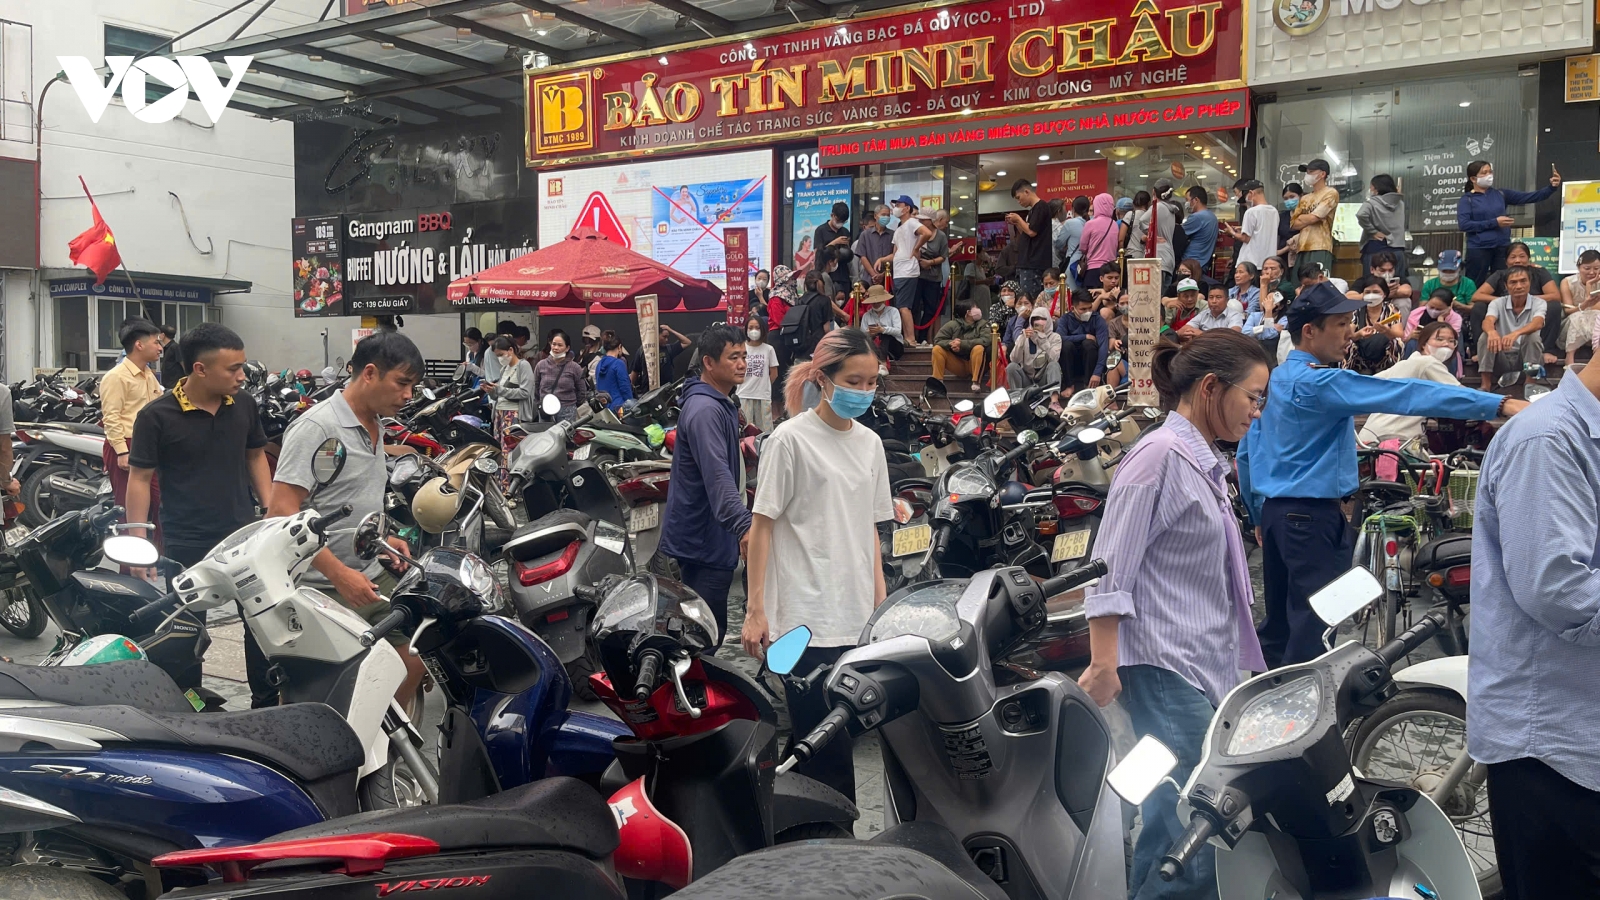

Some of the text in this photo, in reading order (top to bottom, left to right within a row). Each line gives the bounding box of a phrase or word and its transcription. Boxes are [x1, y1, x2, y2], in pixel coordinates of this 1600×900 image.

[720, 44, 759, 65] CÔNG
[763, 43, 781, 59] TY
[783, 38, 822, 56] TNHH
[825, 28, 863, 49] VÀNG
[867, 27, 898, 46] BẠC
[904, 17, 924, 36] ĐÁ
[930, 10, 961, 31] QUÝ
[1008, 0, 1045, 19] LTD)
[603, 0, 1222, 131] BẢO TÍN MINH CHÂU
[620, 64, 1188, 147] KINH DOANH CHẾ TÁC TRANG SỨC VÀNG BẠC ĐÁ QUÝ KIM CƯƠNG MỸ NGHỆ
[820, 98, 1240, 157] TRUNG TÂM MUA BÁN VÀNG MIẾNG ĐƯỢC NHÀ NƯỚC CẤP PHÉP
[544, 132, 584, 144] BTMC 1989
[786, 152, 823, 181] 139
[1423, 164, 1462, 176] Moon
[348, 211, 451, 240] Gangnam BBQ
[347, 257, 372, 281] BUFFET
[374, 240, 434, 286] NƯỚNG
[438, 252, 448, 275] &
[450, 227, 486, 282] LẨU
[63, 283, 87, 292] COMPLEX
[109, 284, 121, 293] CÔNG
[490, 288, 515, 296] Hotline:
[377, 298, 392, 308] CẦU
[393, 297, 409, 307] GIẤY
[452, 296, 486, 305] HOTLINE:
[1132, 379, 1153, 388] 139
[635, 505, 654, 519] 29-L5
[632, 516, 655, 530] 313.16
[898, 527, 925, 542] 29-B1
[1060, 532, 1084, 547] 17-B8
[896, 538, 928, 555] 757.09
[1054, 544, 1085, 560] 087.93
[104, 774, 153, 785] mode
[374, 875, 492, 898] VISION
